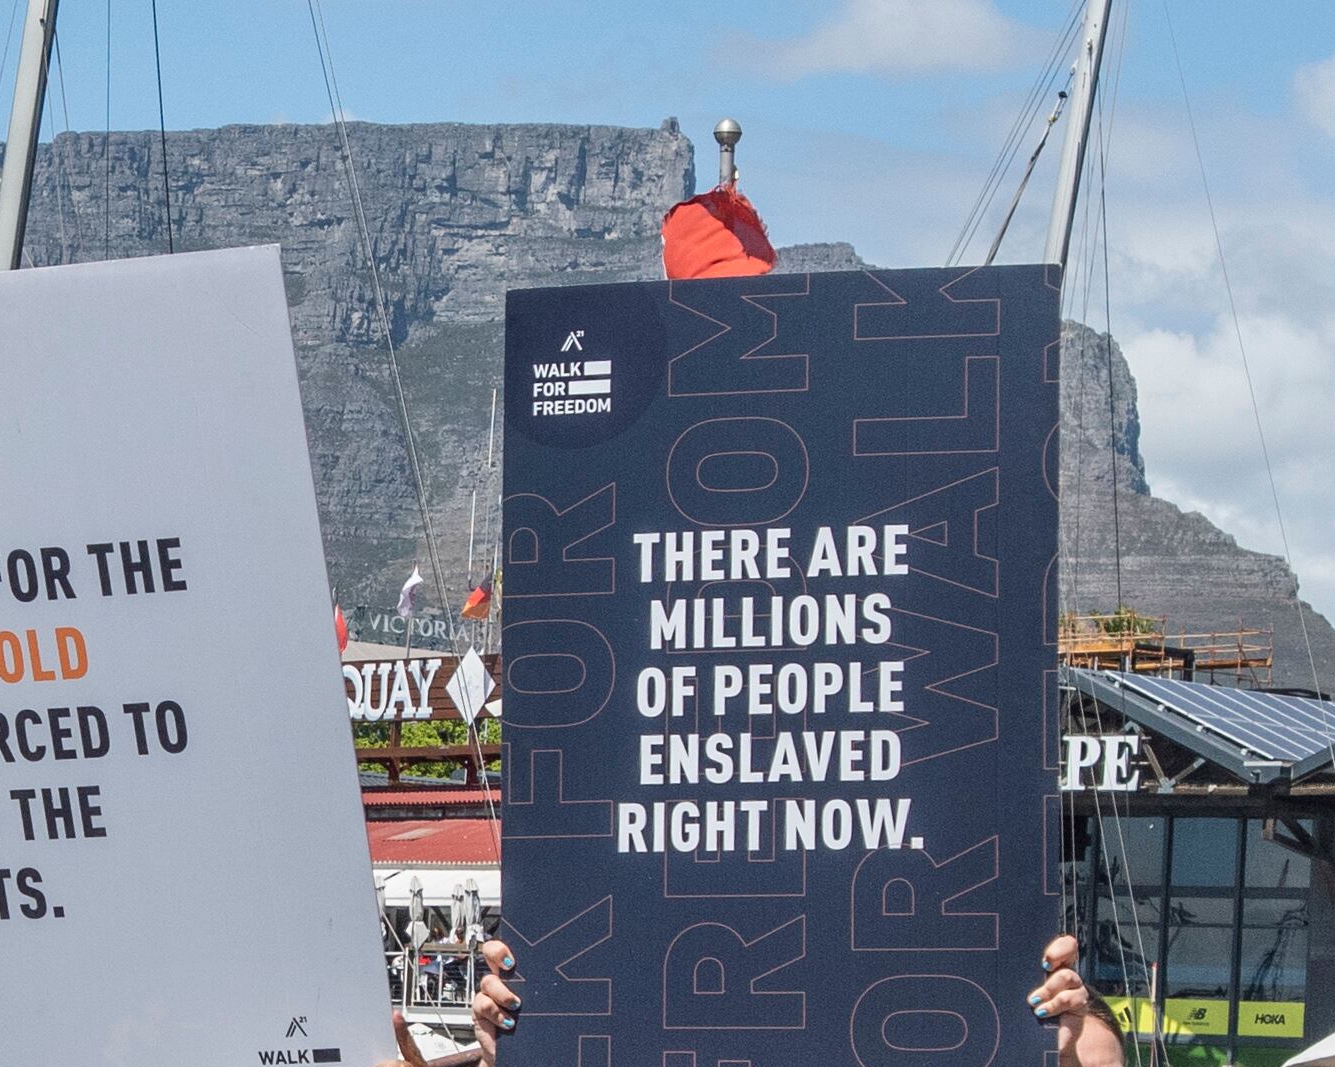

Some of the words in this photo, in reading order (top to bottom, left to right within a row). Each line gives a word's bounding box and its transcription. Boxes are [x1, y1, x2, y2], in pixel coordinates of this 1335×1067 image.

[533, 362, 582, 378] WALK
[533, 381, 566, 397] FOR
[532, 398, 612, 416] FREEDOM
[87, 538, 187, 596] THE
[633, 527, 792, 583] THERE
[806, 524, 910, 578] ARE
[650, 593, 892, 650] MILLIONS
[342, 658, 442, 721] QUAY
[636, 666, 697, 718] OF
[713, 661, 905, 716] PEOPLE
[123, 700, 188, 756] TO
[639, 729, 902, 786] ENSLAVED
[10, 785, 107, 840] THE
[617, 800, 768, 853] RIGHT
[785, 798, 924, 850] NOW.
[1254, 1013, 1286, 1025] HOKA
[258, 1049, 310, 1065] WALK
